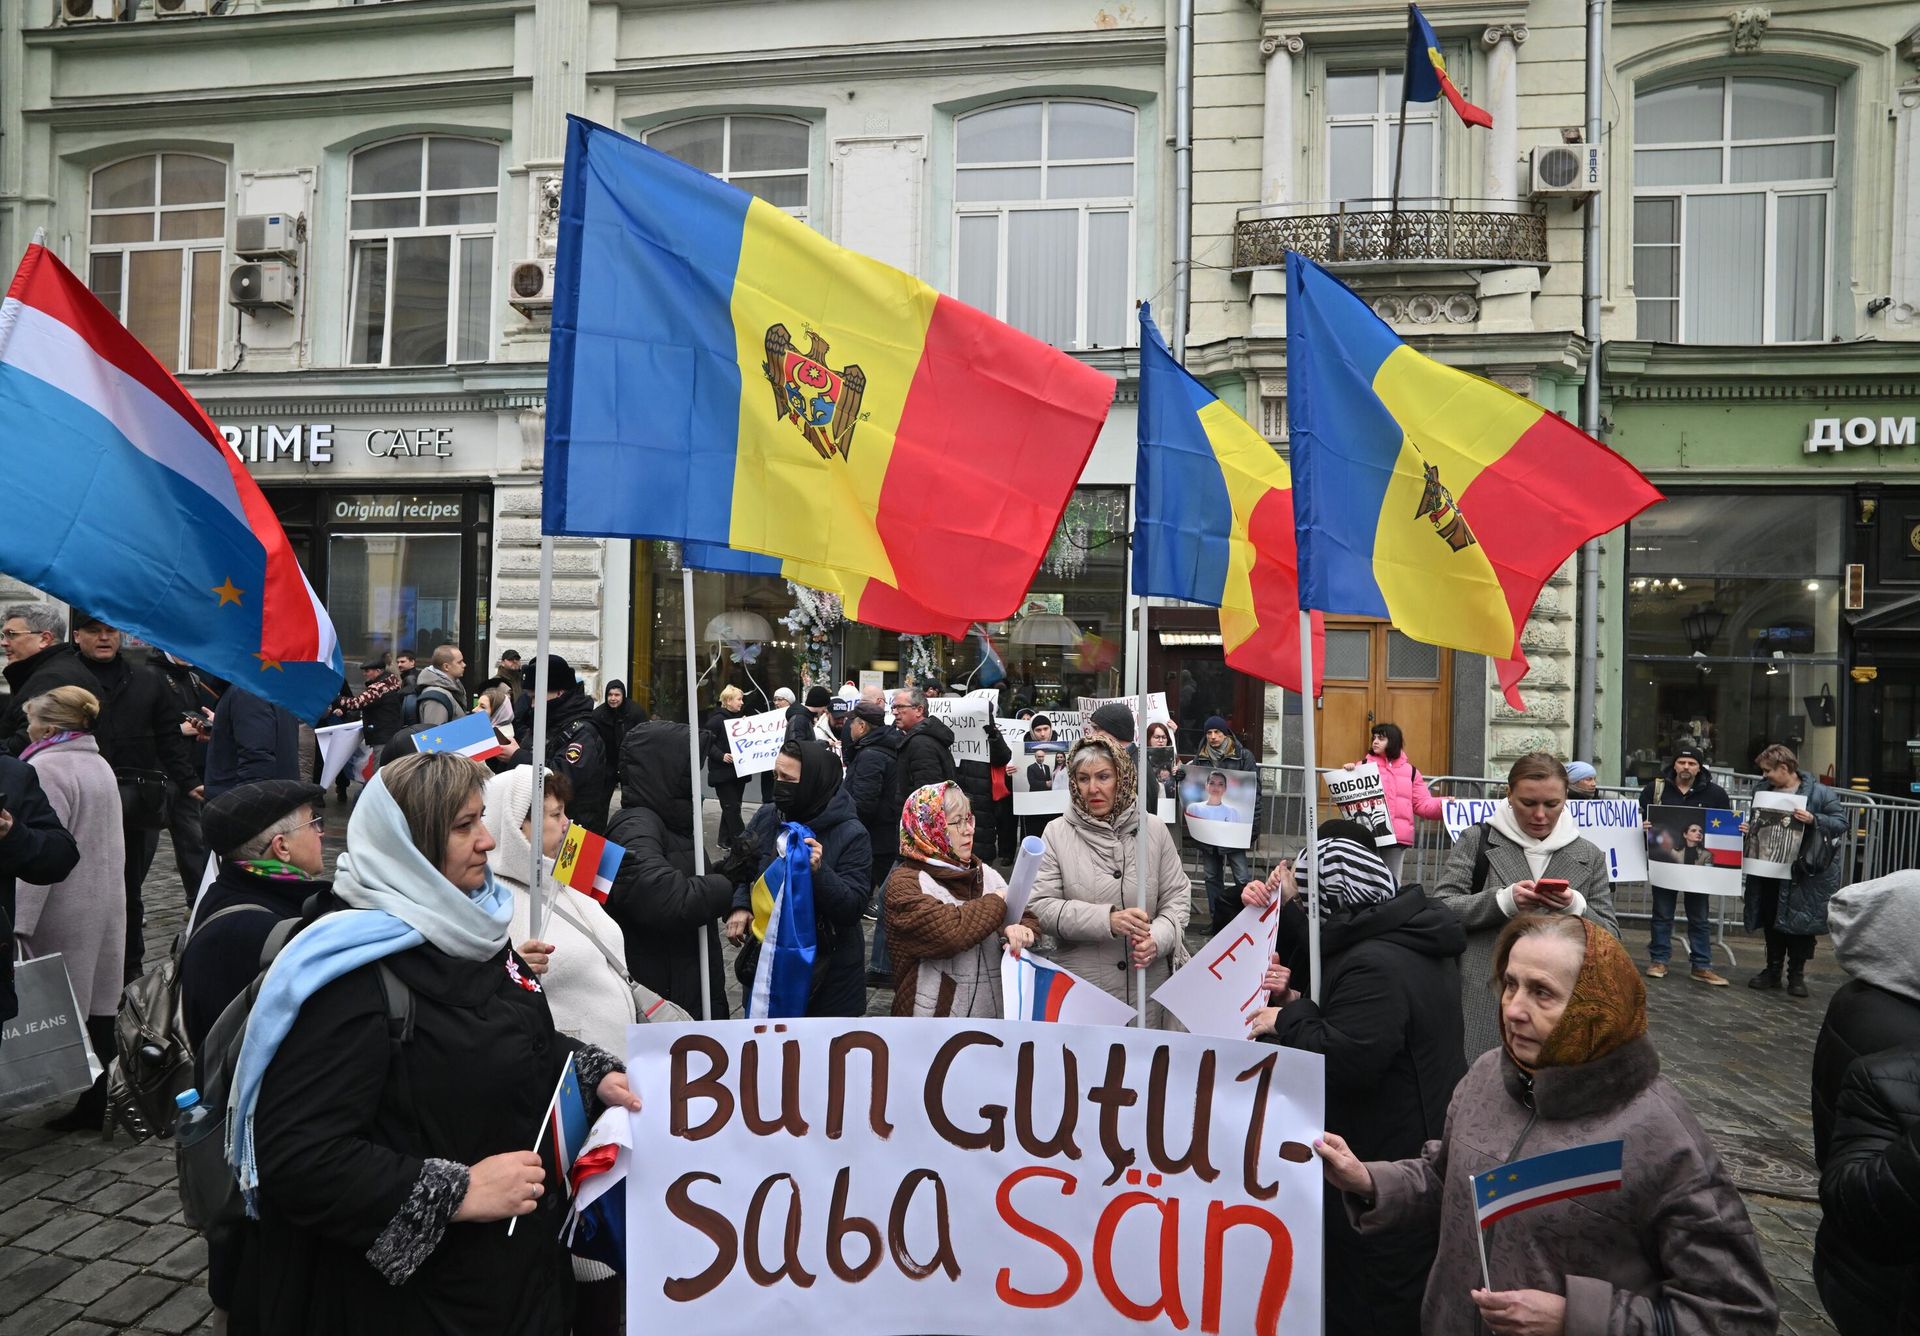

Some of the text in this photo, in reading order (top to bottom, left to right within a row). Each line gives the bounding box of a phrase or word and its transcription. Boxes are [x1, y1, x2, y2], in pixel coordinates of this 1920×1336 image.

[1589, 148, 1597, 183] BEKO
[365, 428, 453, 458] CAFE
[1804, 416, 1917, 453] ДОМ
[335, 500, 460, 522] Original recipes
[950, 741, 981, 755] ЕСТИ
[1328, 774, 1380, 796] СВОБОДУ
[1563, 799, 1638, 828] РЕСТОВАЛИ
[25, 1014, 67, 1035] JEANS
